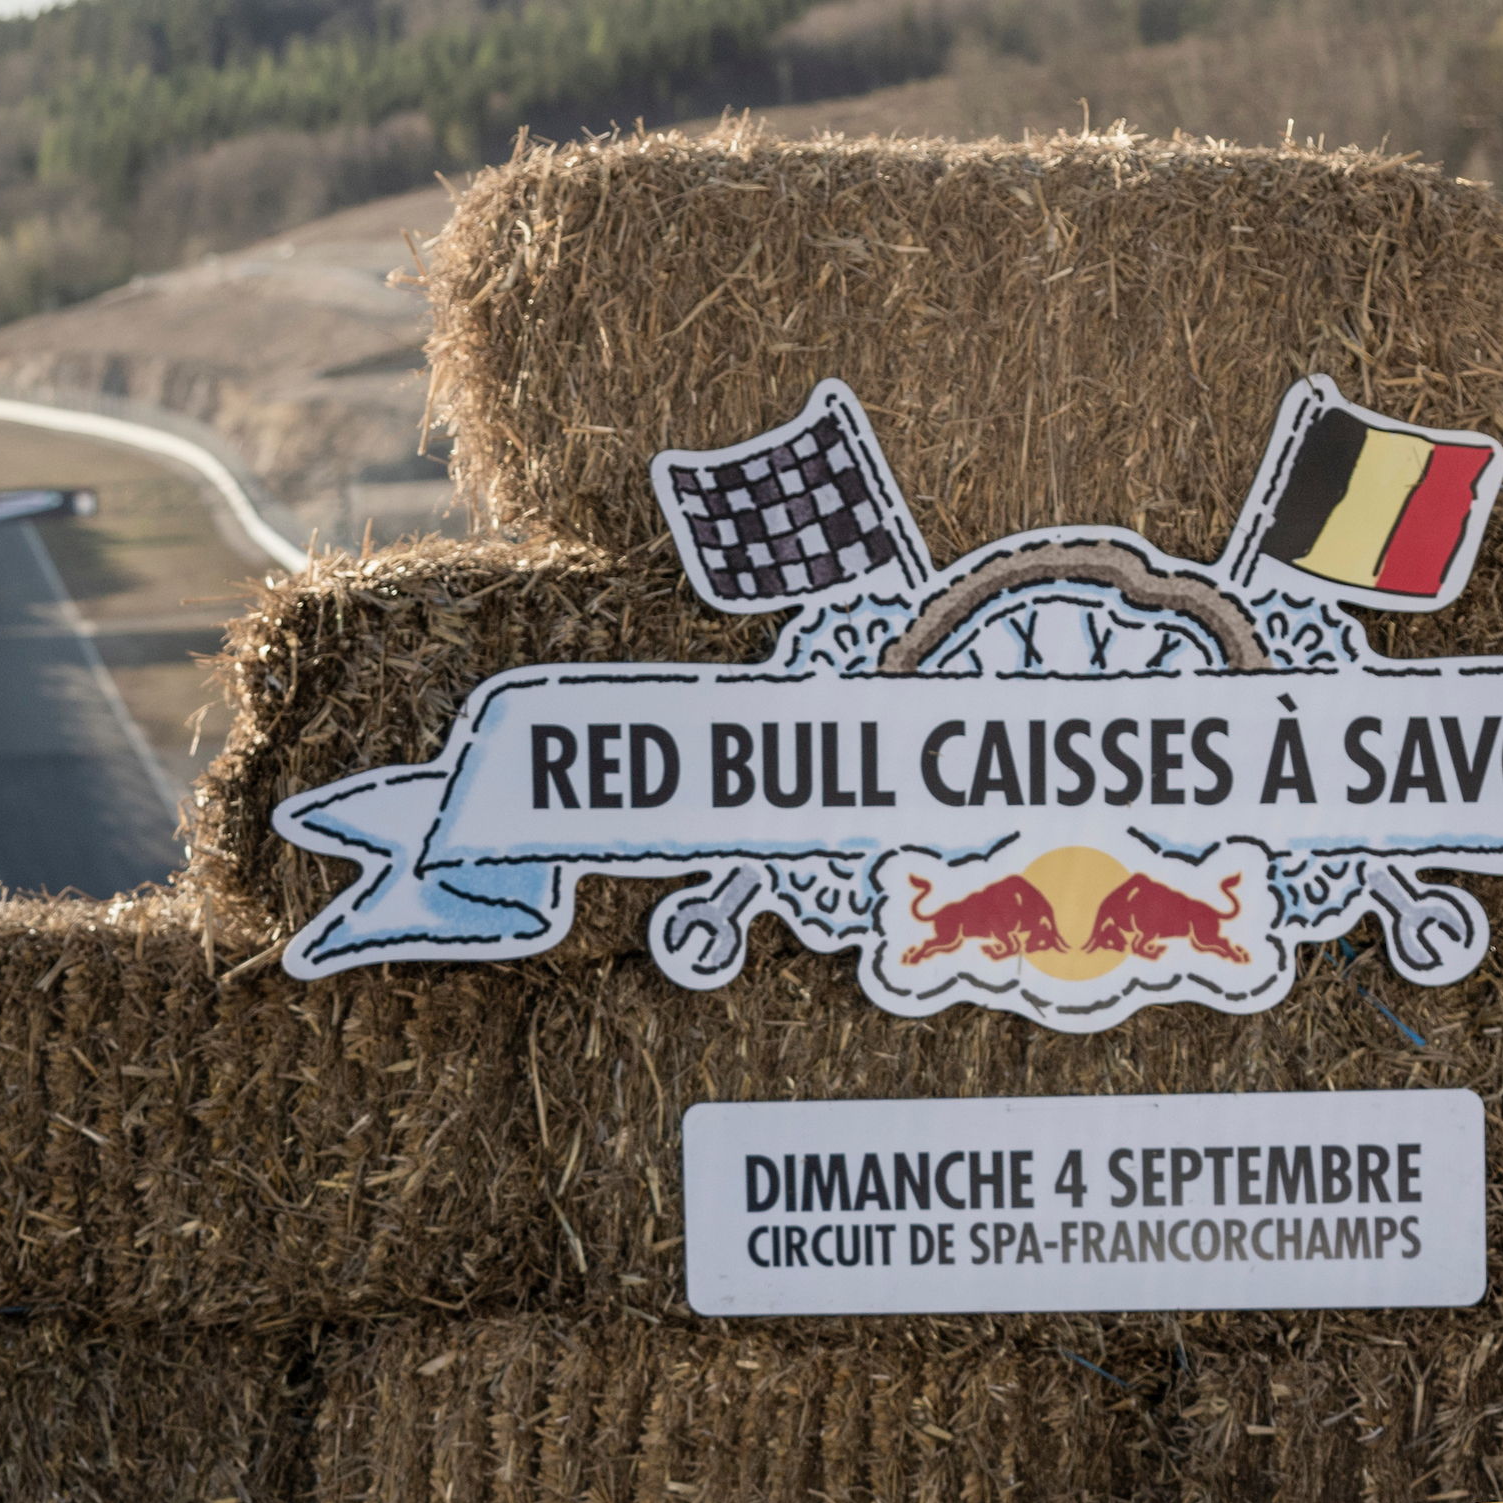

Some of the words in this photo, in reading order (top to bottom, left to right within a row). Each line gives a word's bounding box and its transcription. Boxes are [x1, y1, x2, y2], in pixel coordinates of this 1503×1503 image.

[530, 723, 681, 810] RED
[711, 721, 896, 809] BULL
[920, 717, 1234, 807] CAISSES
[1259, 693, 1317, 804] À
[745, 1151, 1034, 1213] DIMANCHE
[1054, 1149, 1087, 1208] 4
[1108, 1144, 1422, 1208] SEPTEMBRE
[747, 1224, 897, 1268] CIRCUIT
[909, 1223, 955, 1266] DE
[969, 1217, 1421, 1265] SPA-FRANCORCHAMPS
